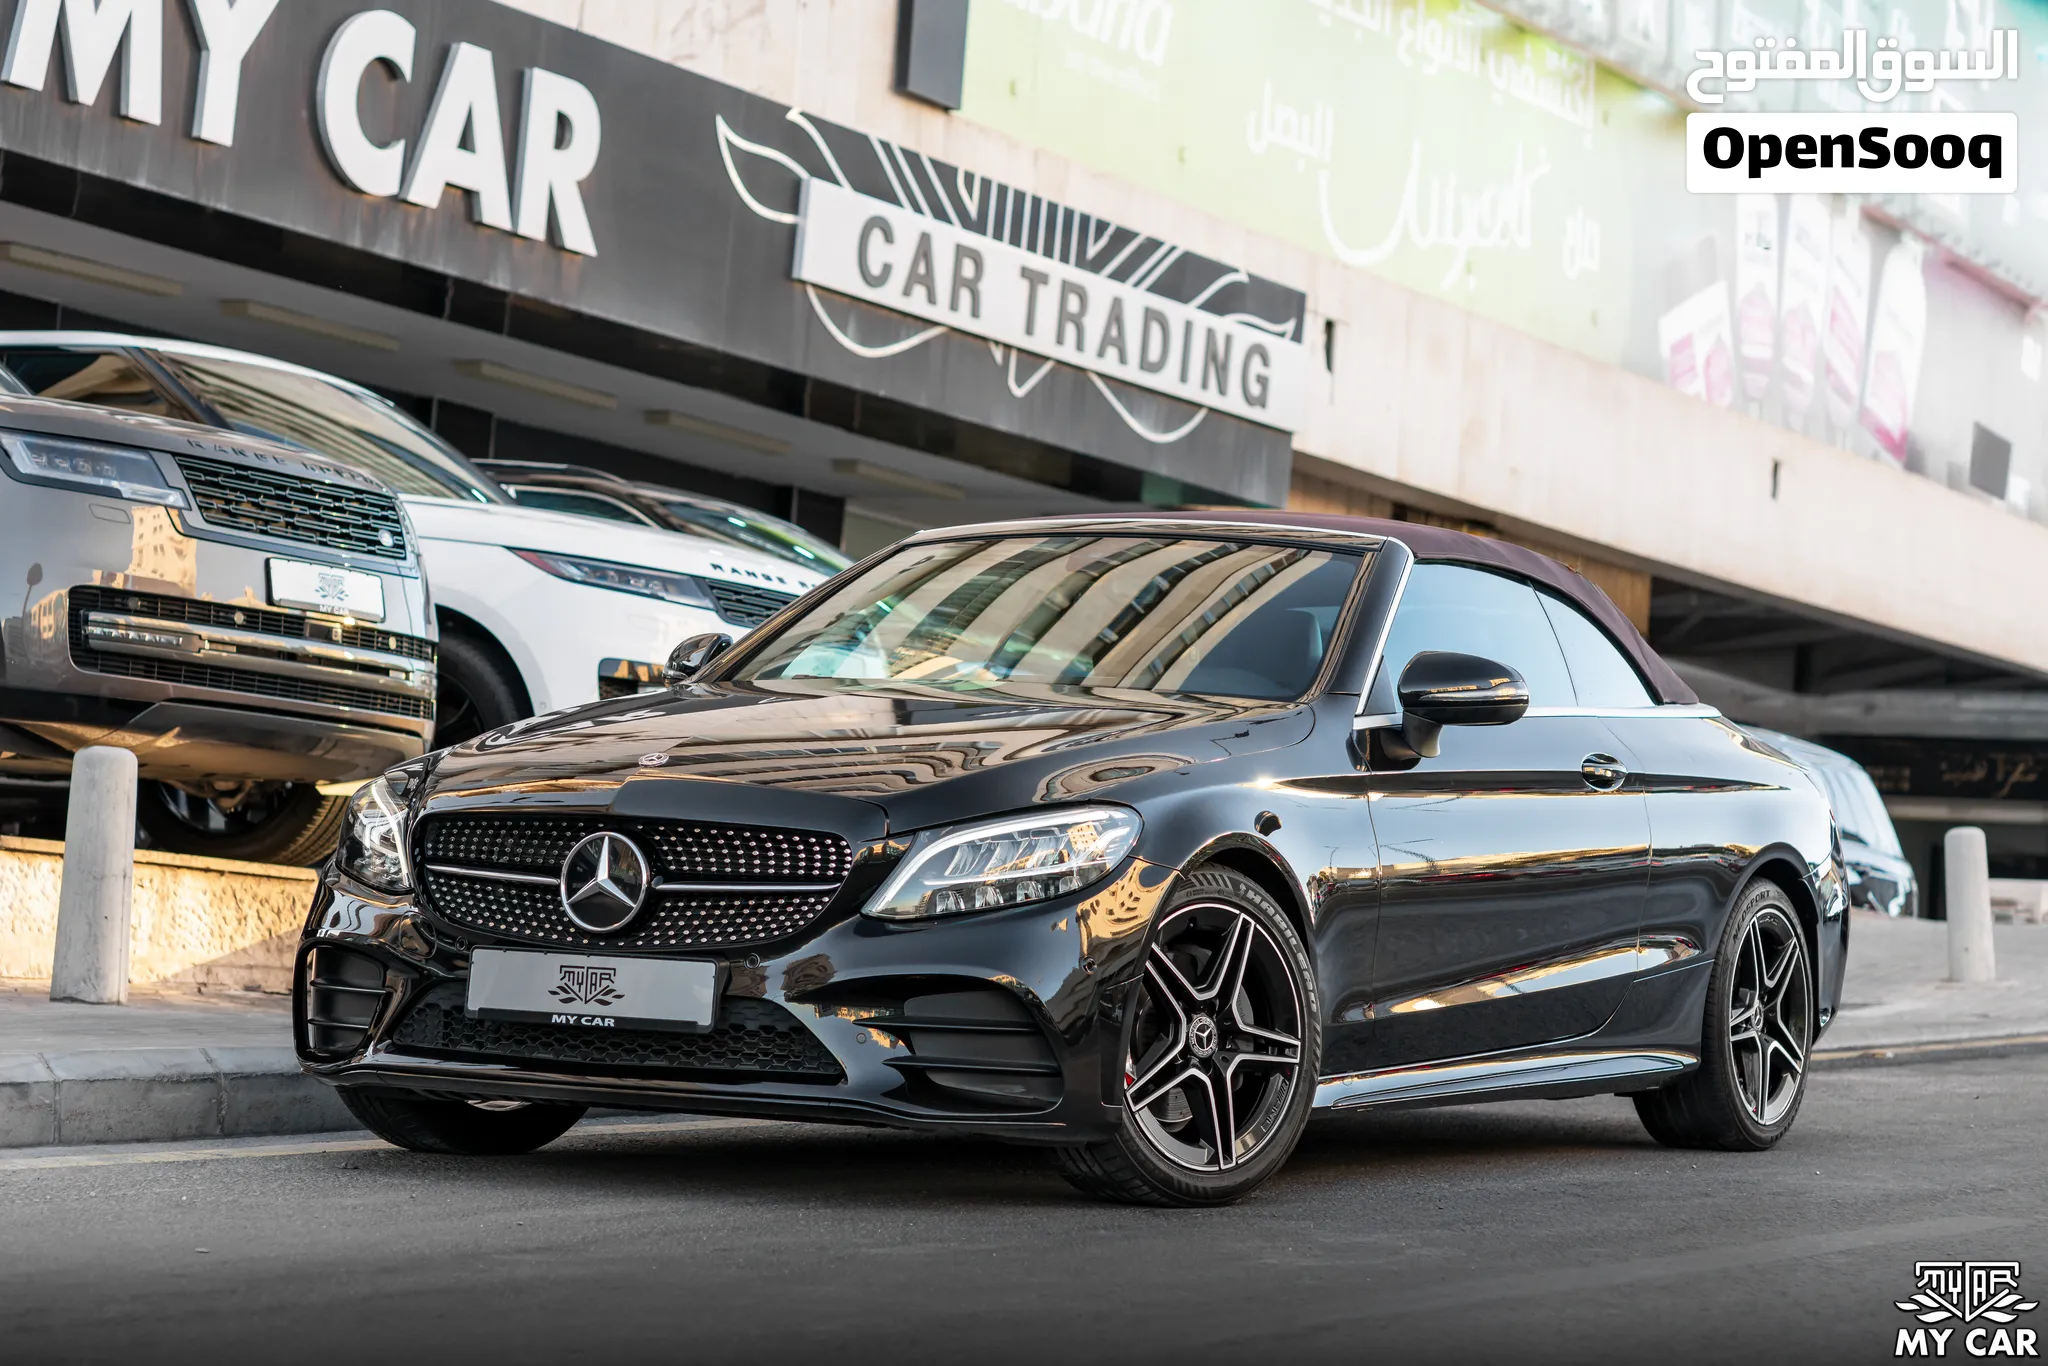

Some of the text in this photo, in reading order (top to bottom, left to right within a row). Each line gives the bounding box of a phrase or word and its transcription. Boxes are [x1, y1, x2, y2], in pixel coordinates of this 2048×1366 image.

[1, 0, 602, 257] MY CAR
[857, 214, 1271, 409] CAR TRADING
[1245, 888, 1317, 1014] HABILEAD
[1732, 889, 1771, 944] NEOSPORT
[551, 1014, 615, 1027] MY CAR
